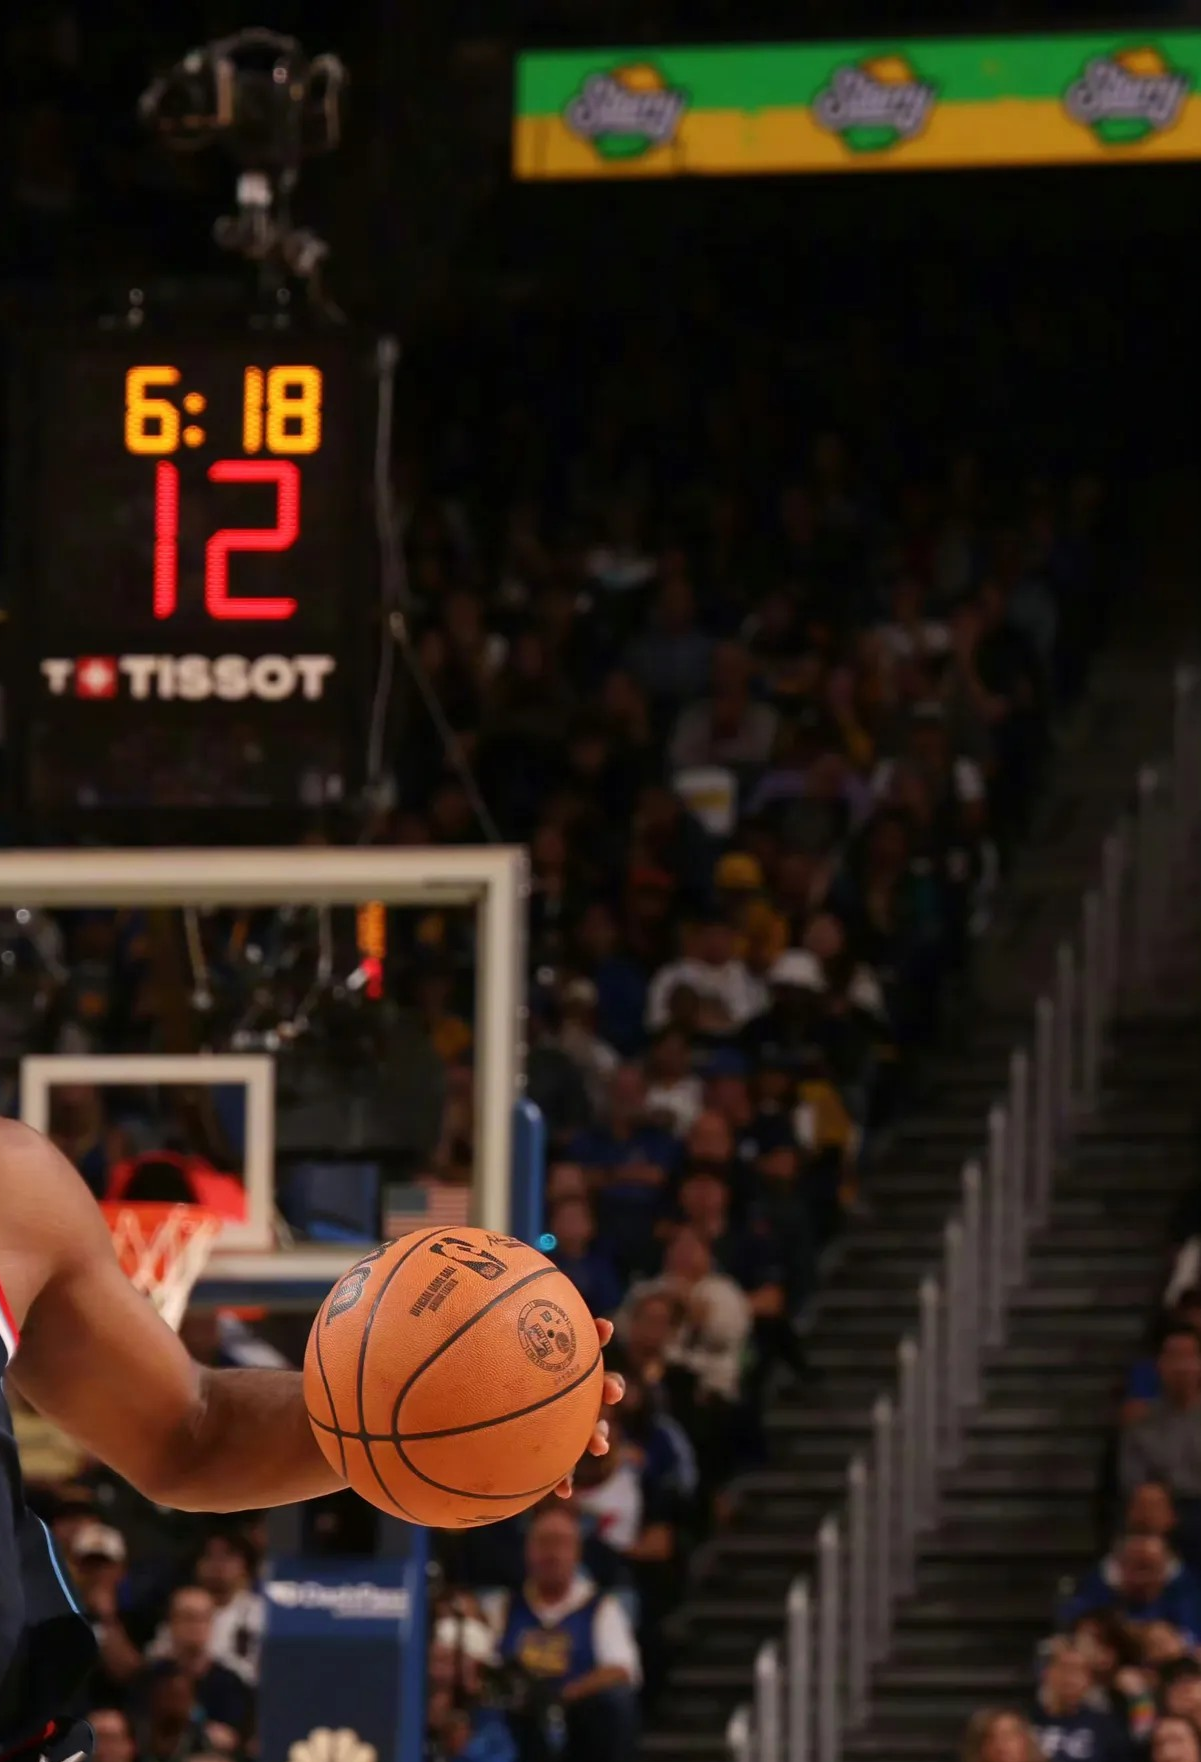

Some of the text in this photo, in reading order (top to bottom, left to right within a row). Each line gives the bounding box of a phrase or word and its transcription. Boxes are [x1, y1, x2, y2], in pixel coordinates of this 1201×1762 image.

[123, 364, 324, 455] 6:18
[152, 458, 301, 621] 12
[120, 654, 336, 701] TISSOT
